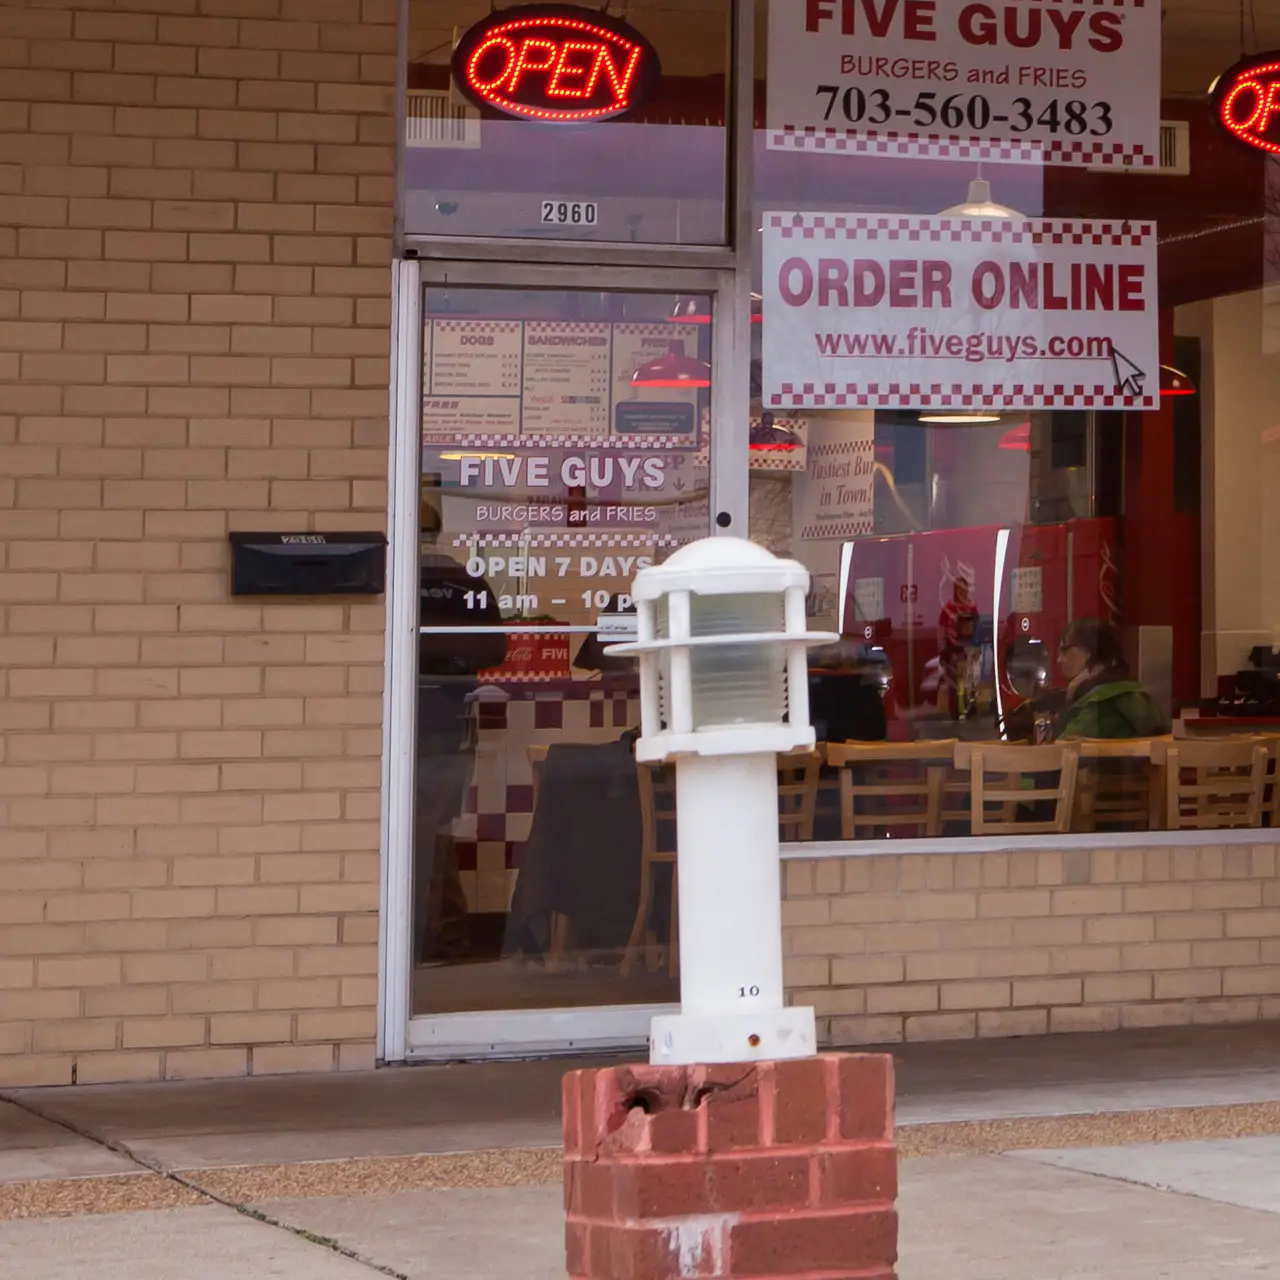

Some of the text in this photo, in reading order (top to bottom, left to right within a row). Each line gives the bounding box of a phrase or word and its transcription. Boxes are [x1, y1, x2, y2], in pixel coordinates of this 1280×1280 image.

[958, 4, 1124, 52] GUYS
[467, 32, 641, 102] OPEN
[840, 54, 1088, 89] BURGERS and FRIES
[815, 85, 1113, 137] 703-560-3483
[541, 200, 598, 225] 2960
[778, 258, 1146, 312] ORDER ONLINE
[814, 329, 1114, 362] www.fiveguys.com
[459, 456, 550, 488] FIVE
[561, 456, 667, 489] GUYS
[809, 458, 851, 481] Tastiest
[819, 483, 874, 507] in Town!
[475, 505, 564, 522] BURGERS
[568, 507, 602, 522] and
[605, 505, 657, 522] FRIES
[465, 556, 547, 578] OPEN
[554, 556, 572, 578] 7
[462, 590, 488, 610] 11
[498, 592, 539, 609] am
[581, 589, 611, 609] 10
[736, 984, 761, 999] 10
